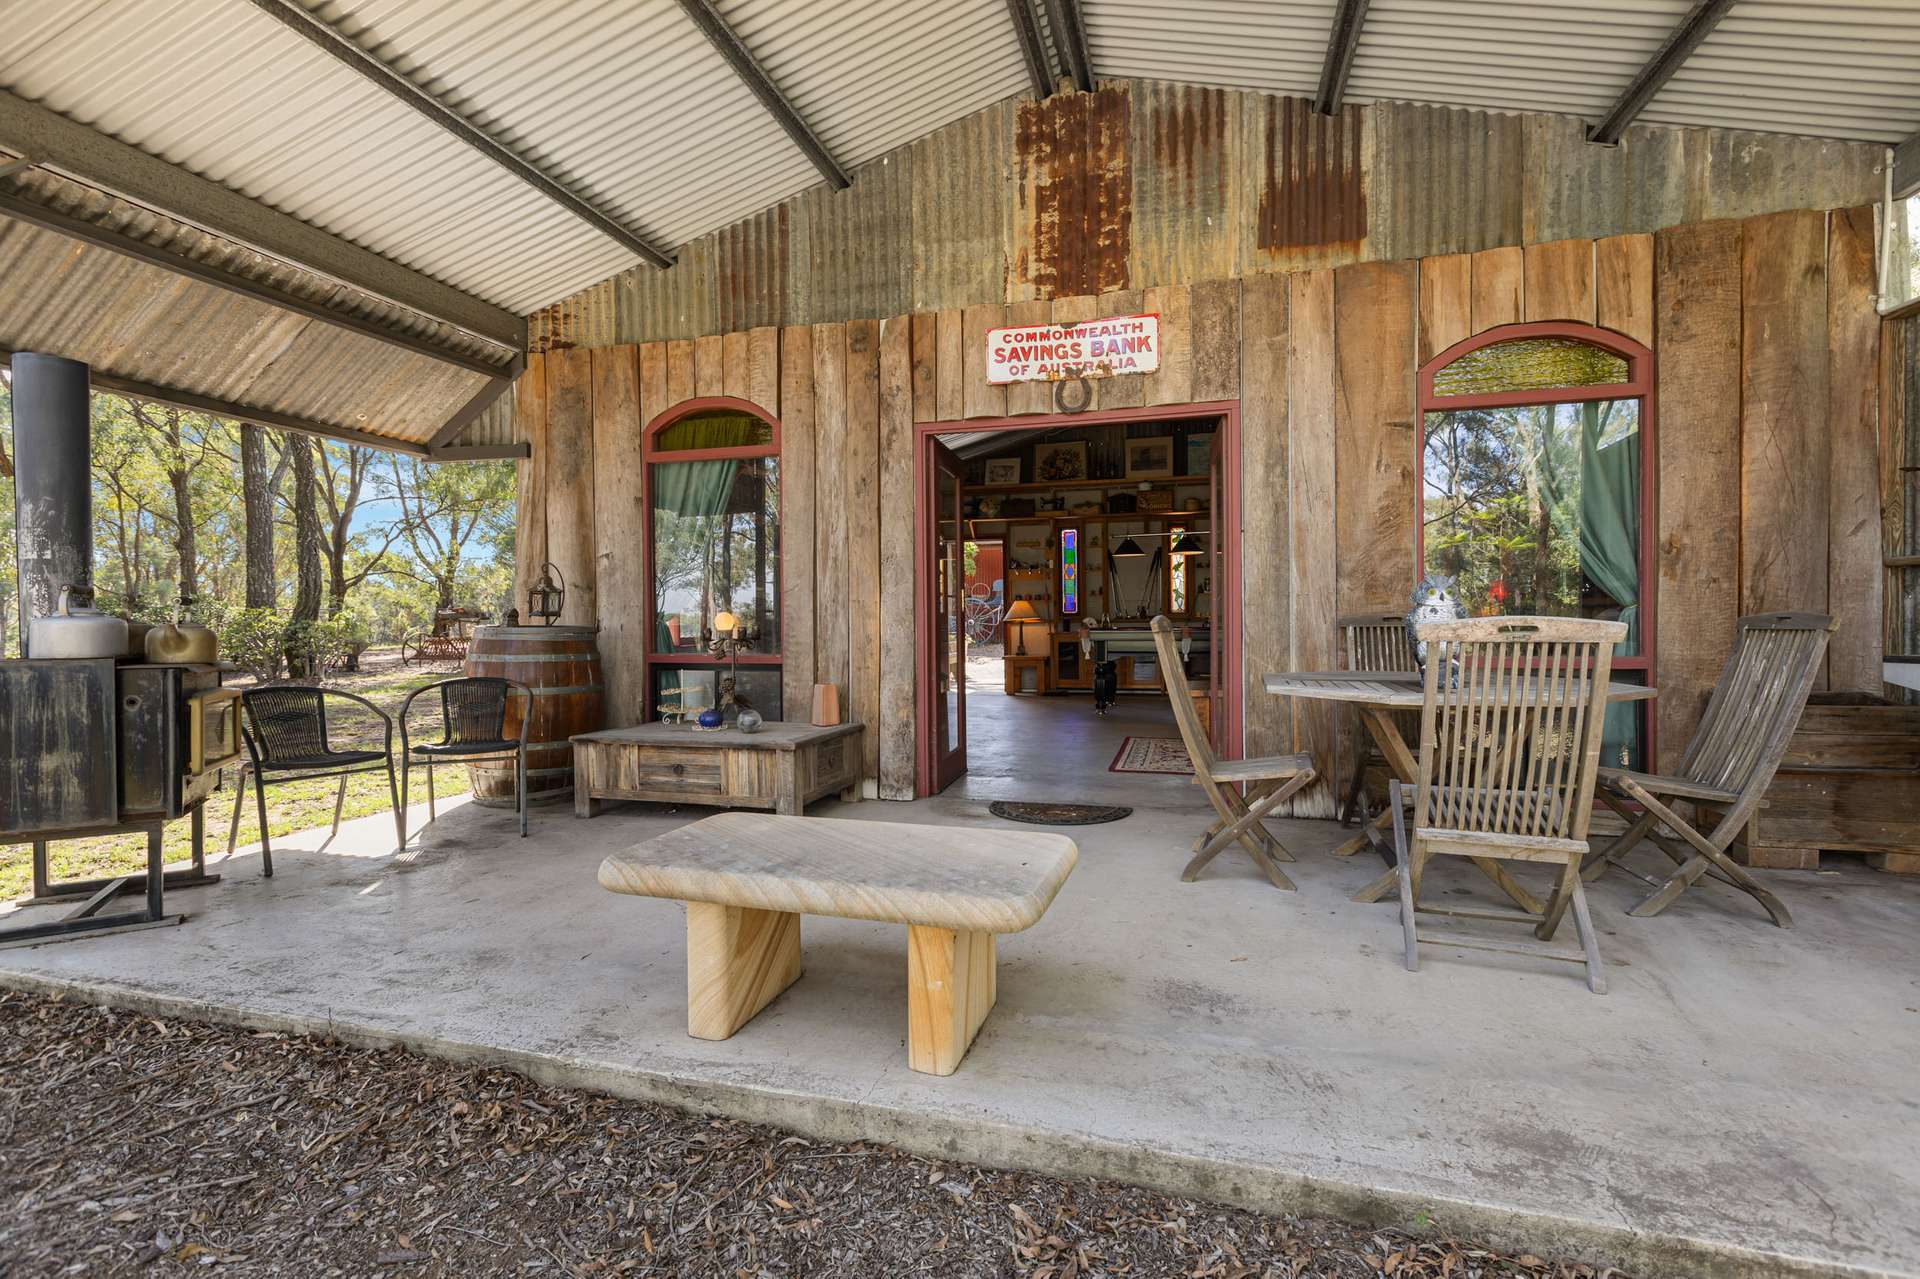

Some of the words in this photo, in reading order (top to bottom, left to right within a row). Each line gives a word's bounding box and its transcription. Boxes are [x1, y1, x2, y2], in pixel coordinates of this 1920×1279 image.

[1002, 322, 1143, 344] COMMONWEALTH
[994, 342, 1083, 364] SAVINGS
[1090, 335, 1152, 358] BANK
[1009, 364, 1030, 376] OF
